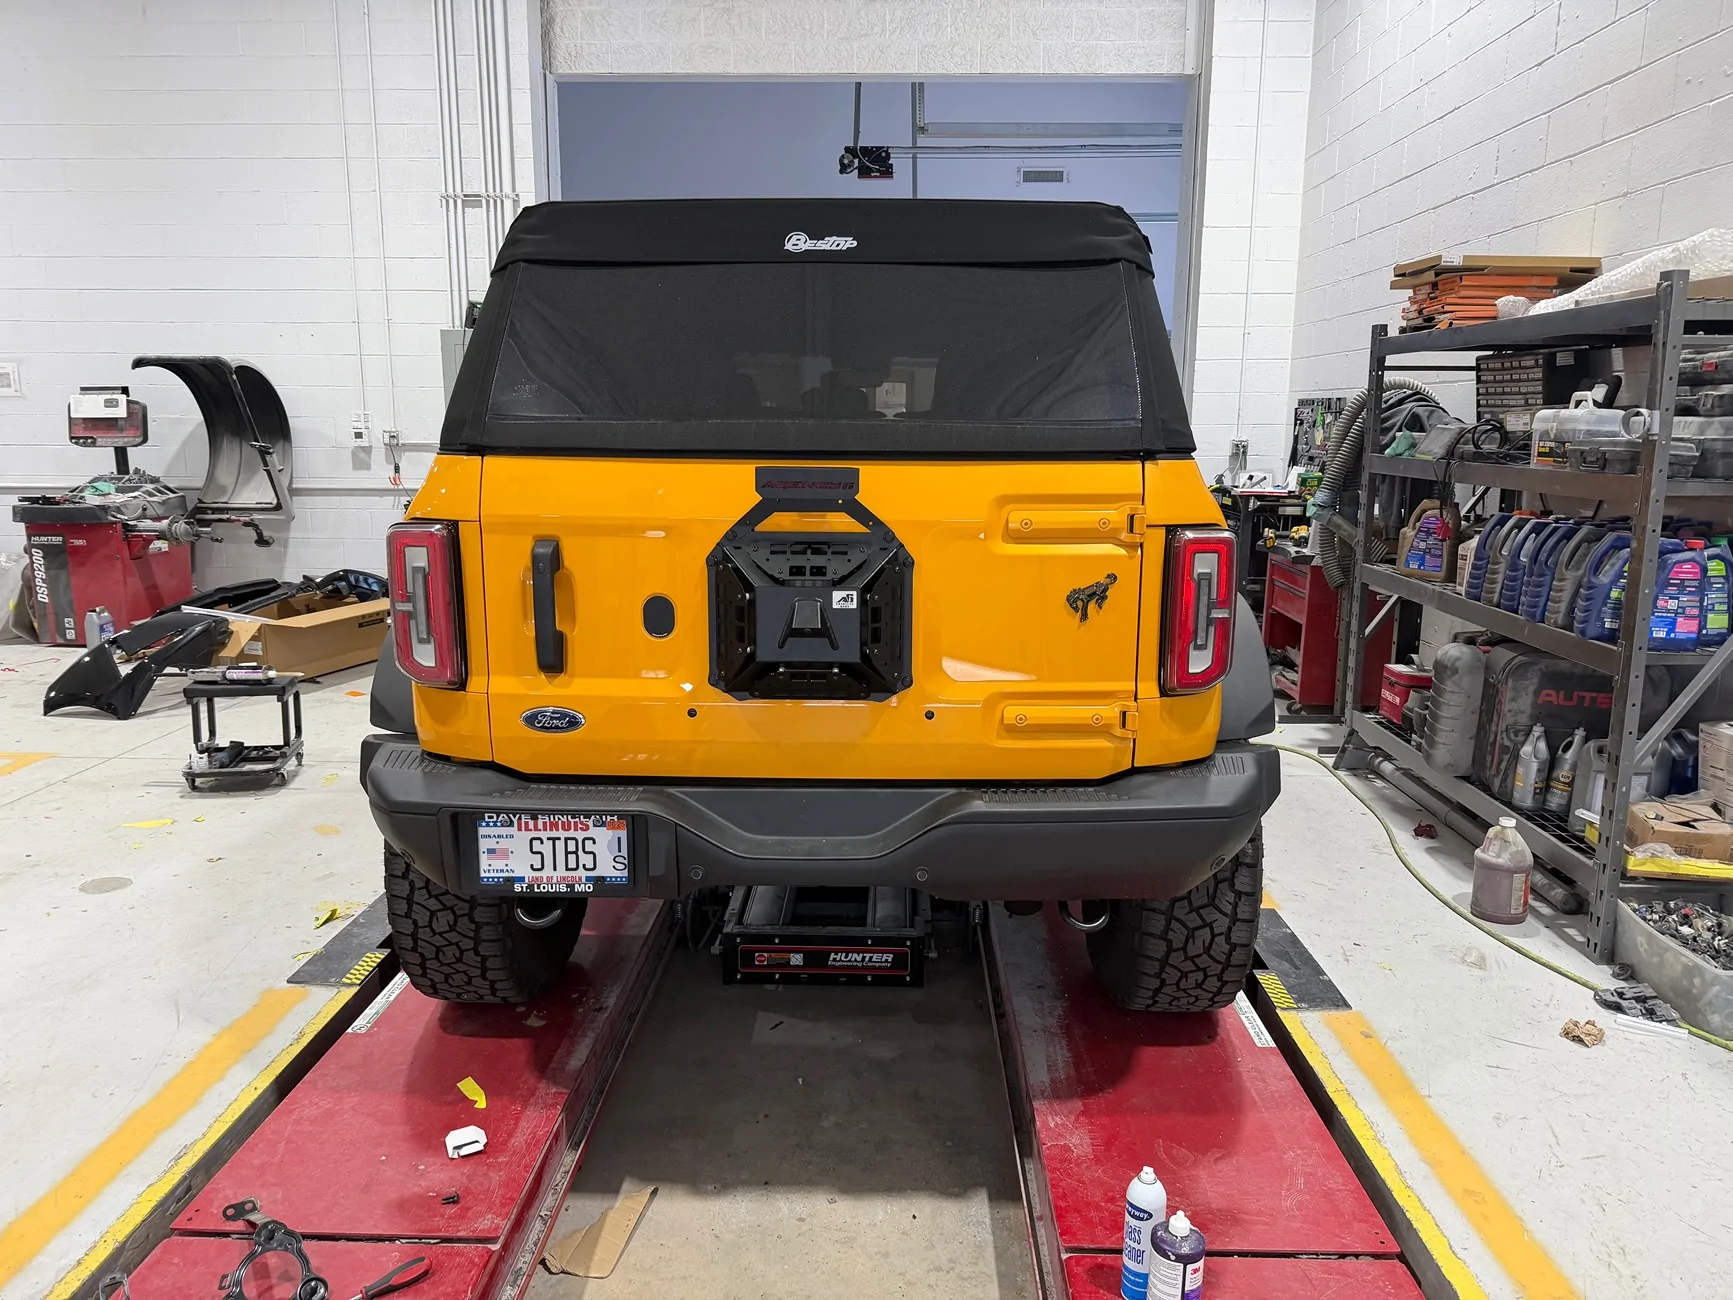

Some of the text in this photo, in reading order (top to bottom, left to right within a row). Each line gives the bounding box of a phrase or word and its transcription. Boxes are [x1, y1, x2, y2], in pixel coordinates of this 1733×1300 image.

[31, 548, 49, 603] DSP9200
[1537, 689, 1615, 708] AUTE
[534, 712, 569, 727] Ford
[517, 819, 590, 832] ILLINOIS
[529, 836, 597, 872] STBS
[514, 884, 594, 892] ST. LOUIS, MO
[829, 952, 894, 962] HUNTER
[1190, 1265, 1201, 1276] 3M
